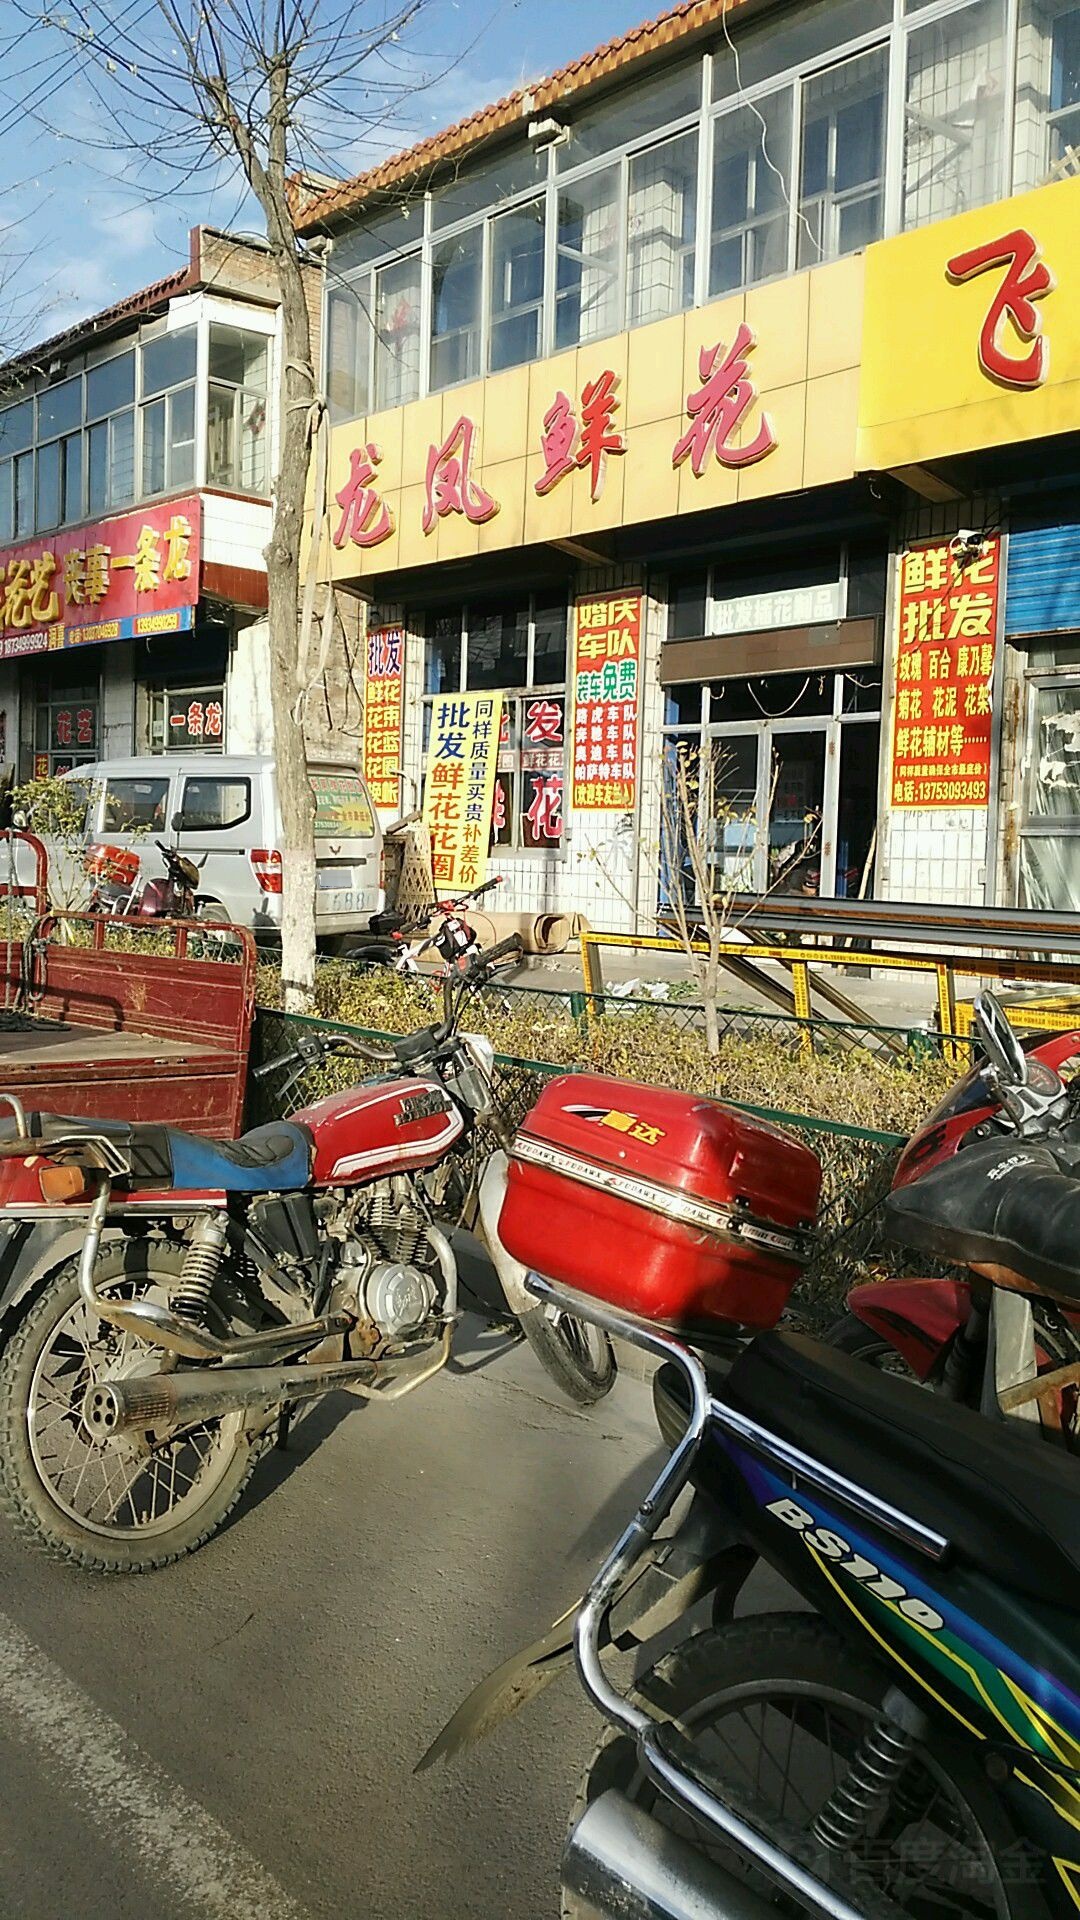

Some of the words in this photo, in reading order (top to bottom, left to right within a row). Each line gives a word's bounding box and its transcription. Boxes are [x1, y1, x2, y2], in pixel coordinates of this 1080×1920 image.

[947, 229, 1057, 390] 飞
[333, 322, 778, 549] 龙凤鲜花
[0, 551, 60, 629] 花艺
[578, 597, 638, 630] 婚庆
[903, 592, 994, 645] 批发
[368, 630, 401, 676] 批发
[578, 628, 637, 660] 车队
[899, 650, 923, 682] 玫瑰
[928, 647, 951, 680] 百合
[956, 643, 993, 678] 康乃馨
[367, 679, 400, 703] 鲜花
[577, 658, 637, 702] 装车免费
[170, 701, 222, 736] 一条龙
[366, 705, 400, 728] 花束
[897, 688, 923, 721] 菊花
[932, 686, 957, 719] 花泥
[765, 1498, 944, 1631] BS110
